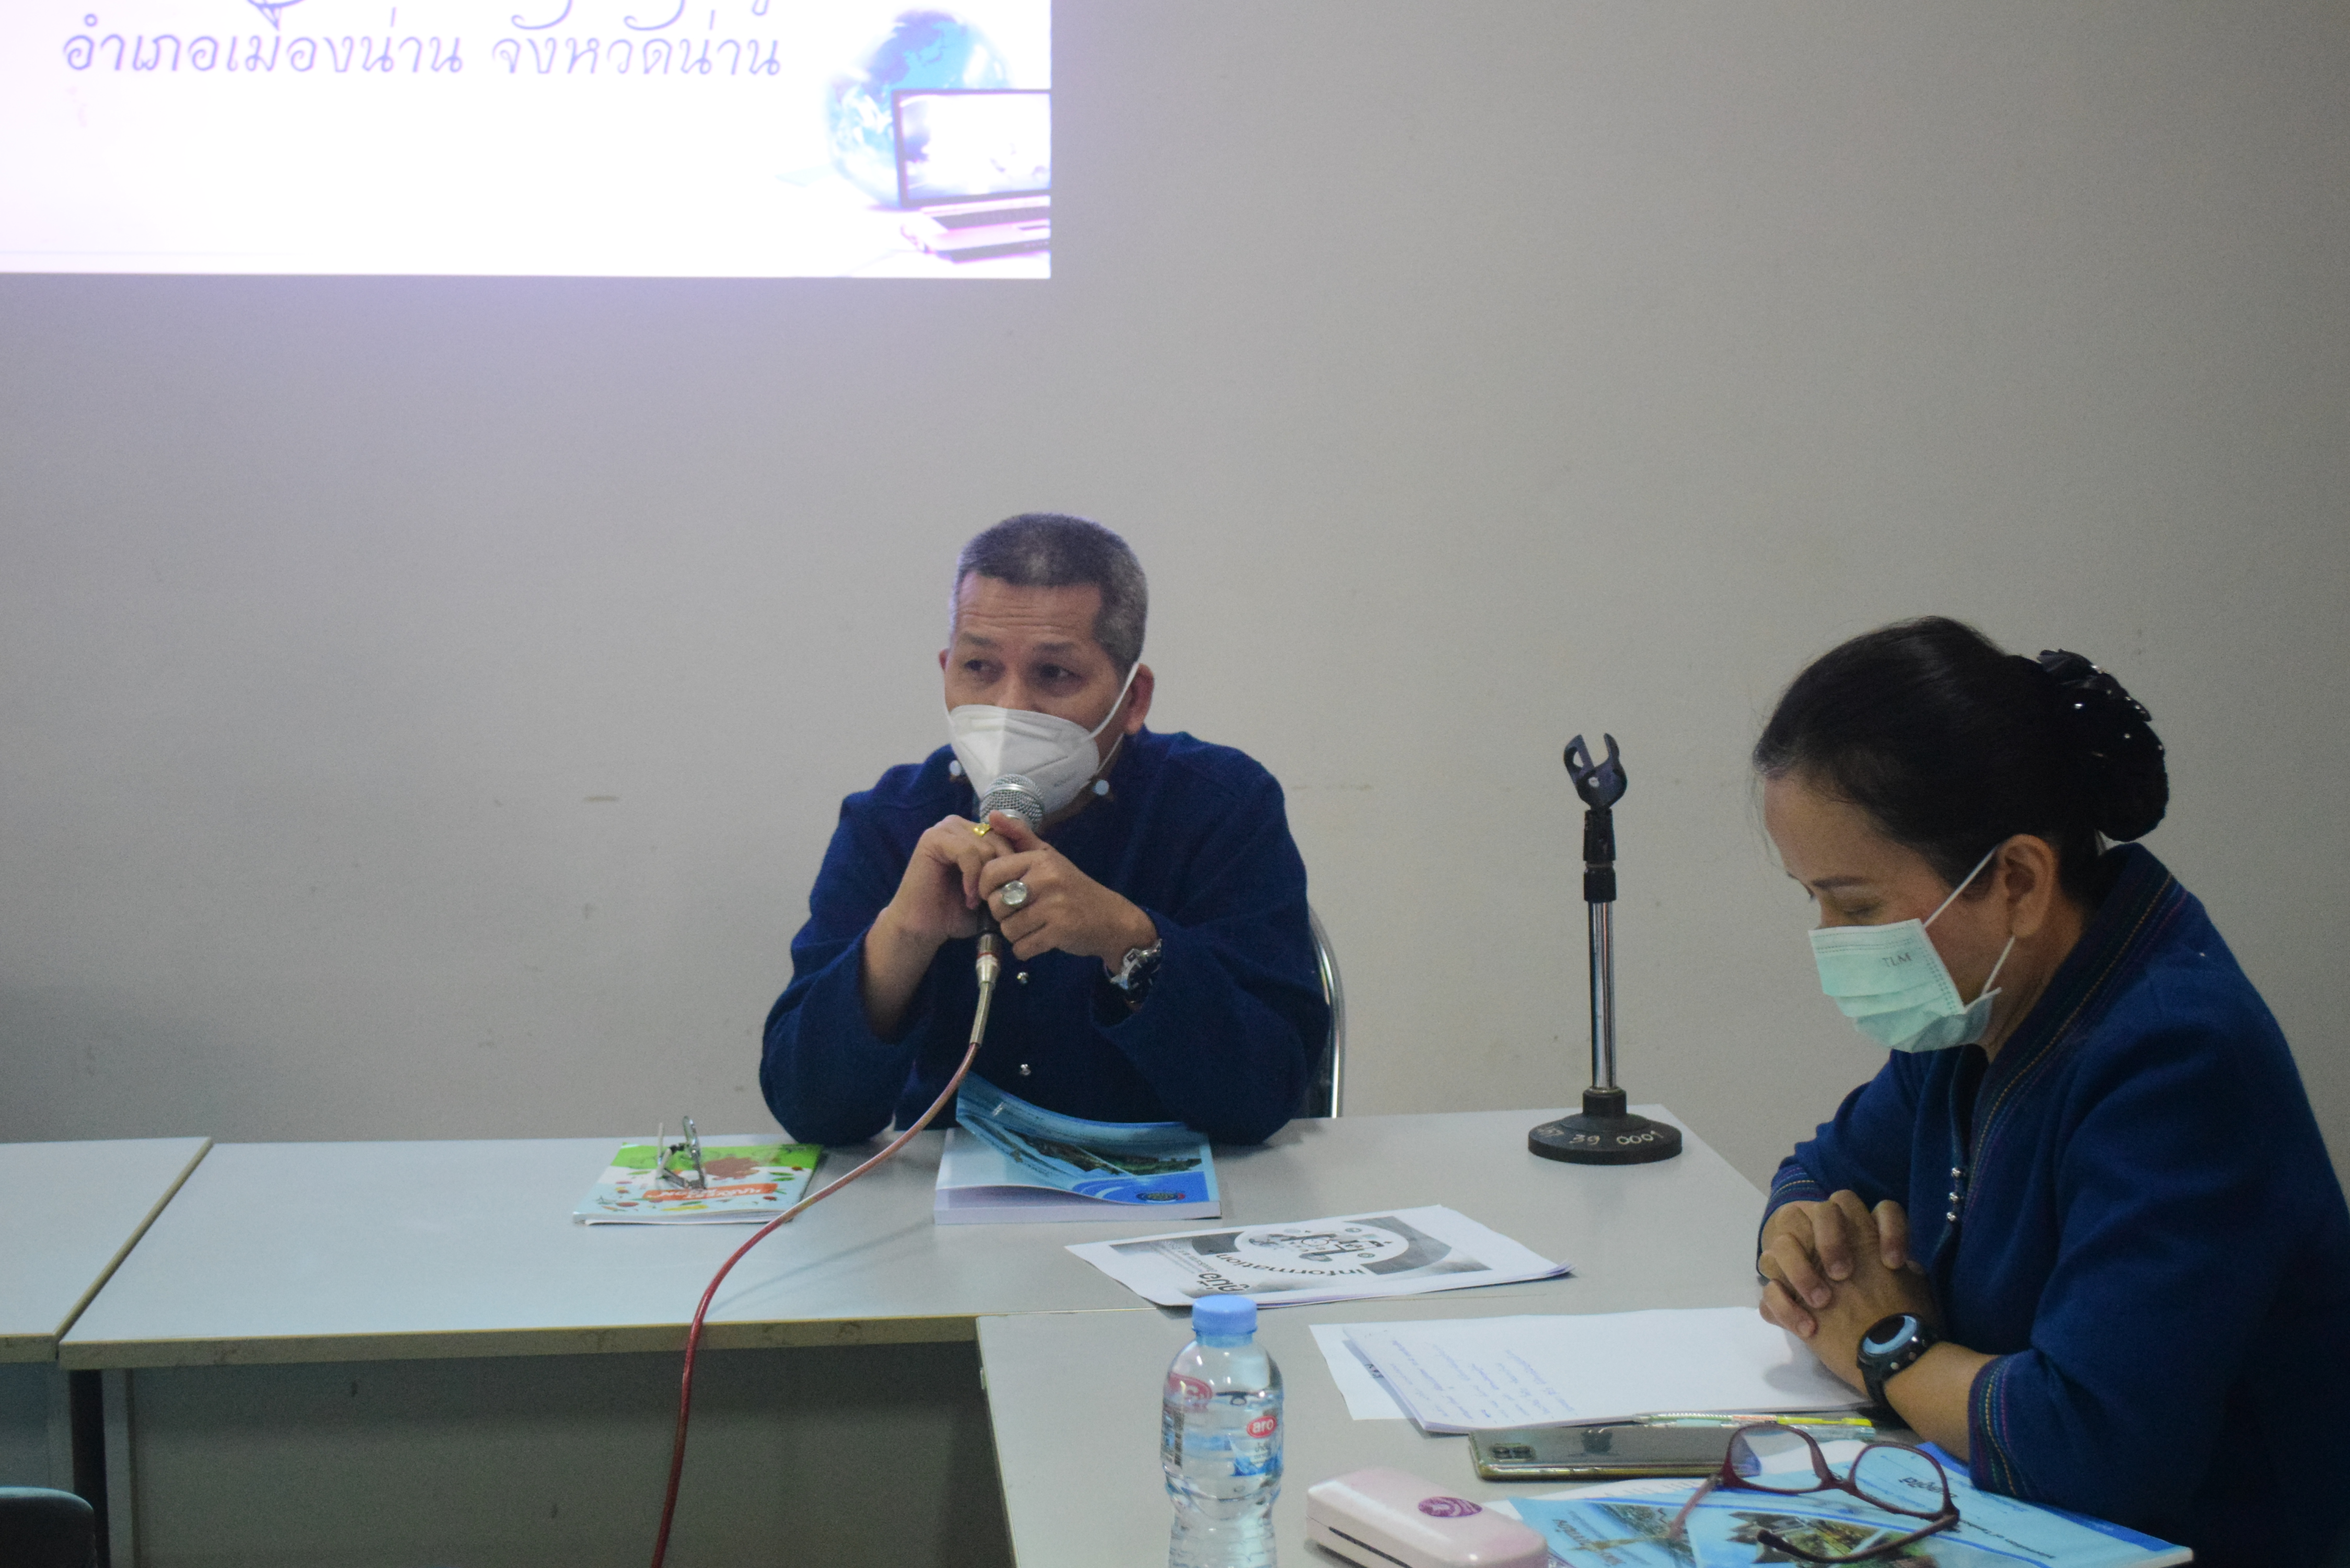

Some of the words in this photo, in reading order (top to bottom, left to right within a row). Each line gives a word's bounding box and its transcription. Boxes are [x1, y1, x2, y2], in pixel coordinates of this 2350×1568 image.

[63, 0, 462, 73] อำเภอเมืองน่าน
[492, 0, 780, 75] จังหวัดน่าน
[1252, 1419, 1274, 1433] aro
